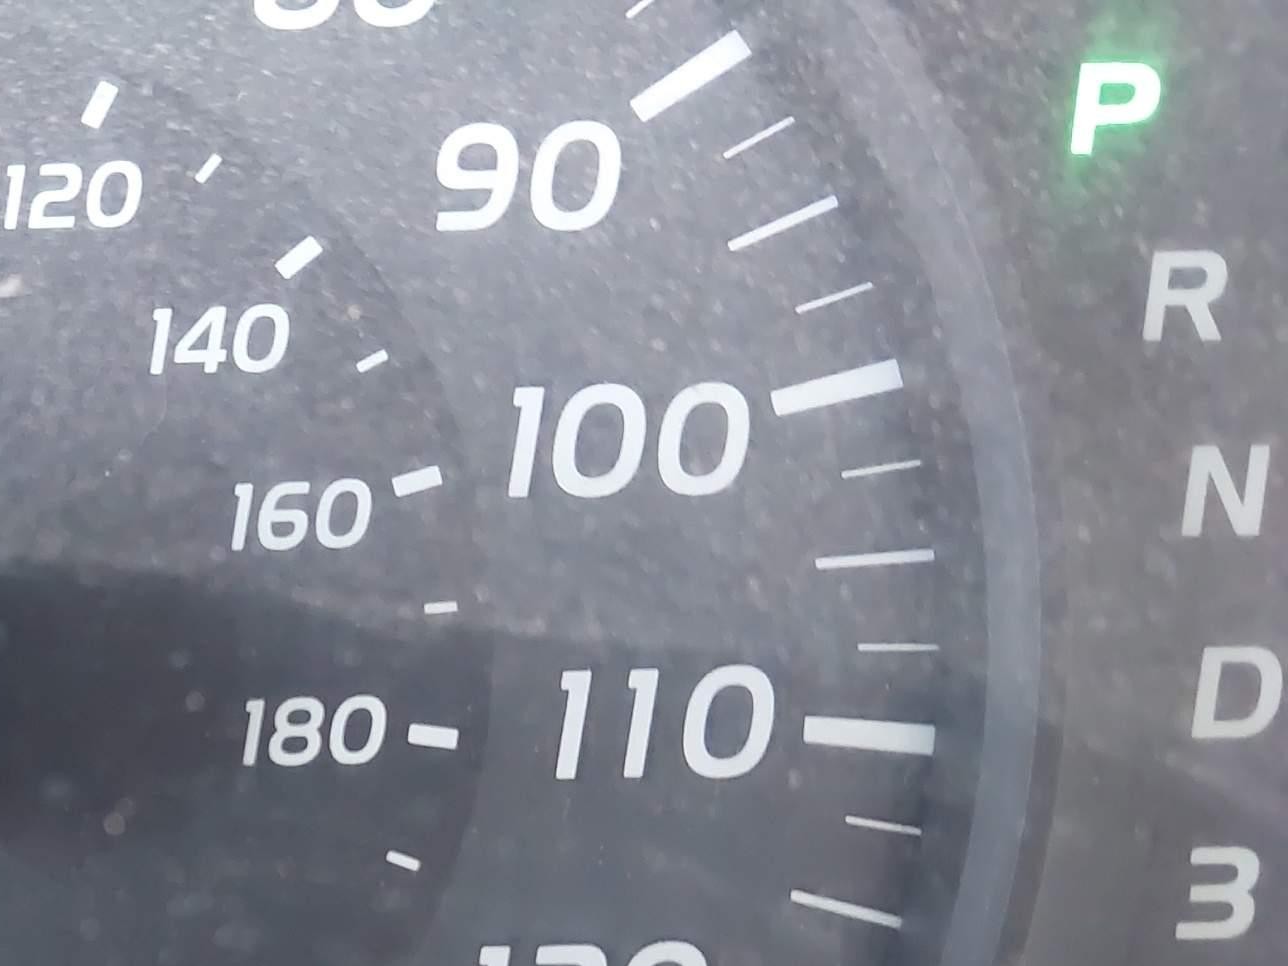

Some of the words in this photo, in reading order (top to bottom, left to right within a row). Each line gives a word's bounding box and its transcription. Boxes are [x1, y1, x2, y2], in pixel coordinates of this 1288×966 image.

[1070, 61, 1162, 156] P
[4, 160, 143, 230] 120
[436, 120, 622, 232] 90
[150, 303, 290, 375] 140
[1143, 249, 1228, 342] R
[508, 381, 751, 499] 100
[231, 478, 372, 551] 160
[1181, 444, 1271, 537] N
[242, 694, 387, 767] 180
[555, 664, 776, 780] 110
[1191, 645, 1283, 740] D
[1174, 846, 1261, 940] 3
